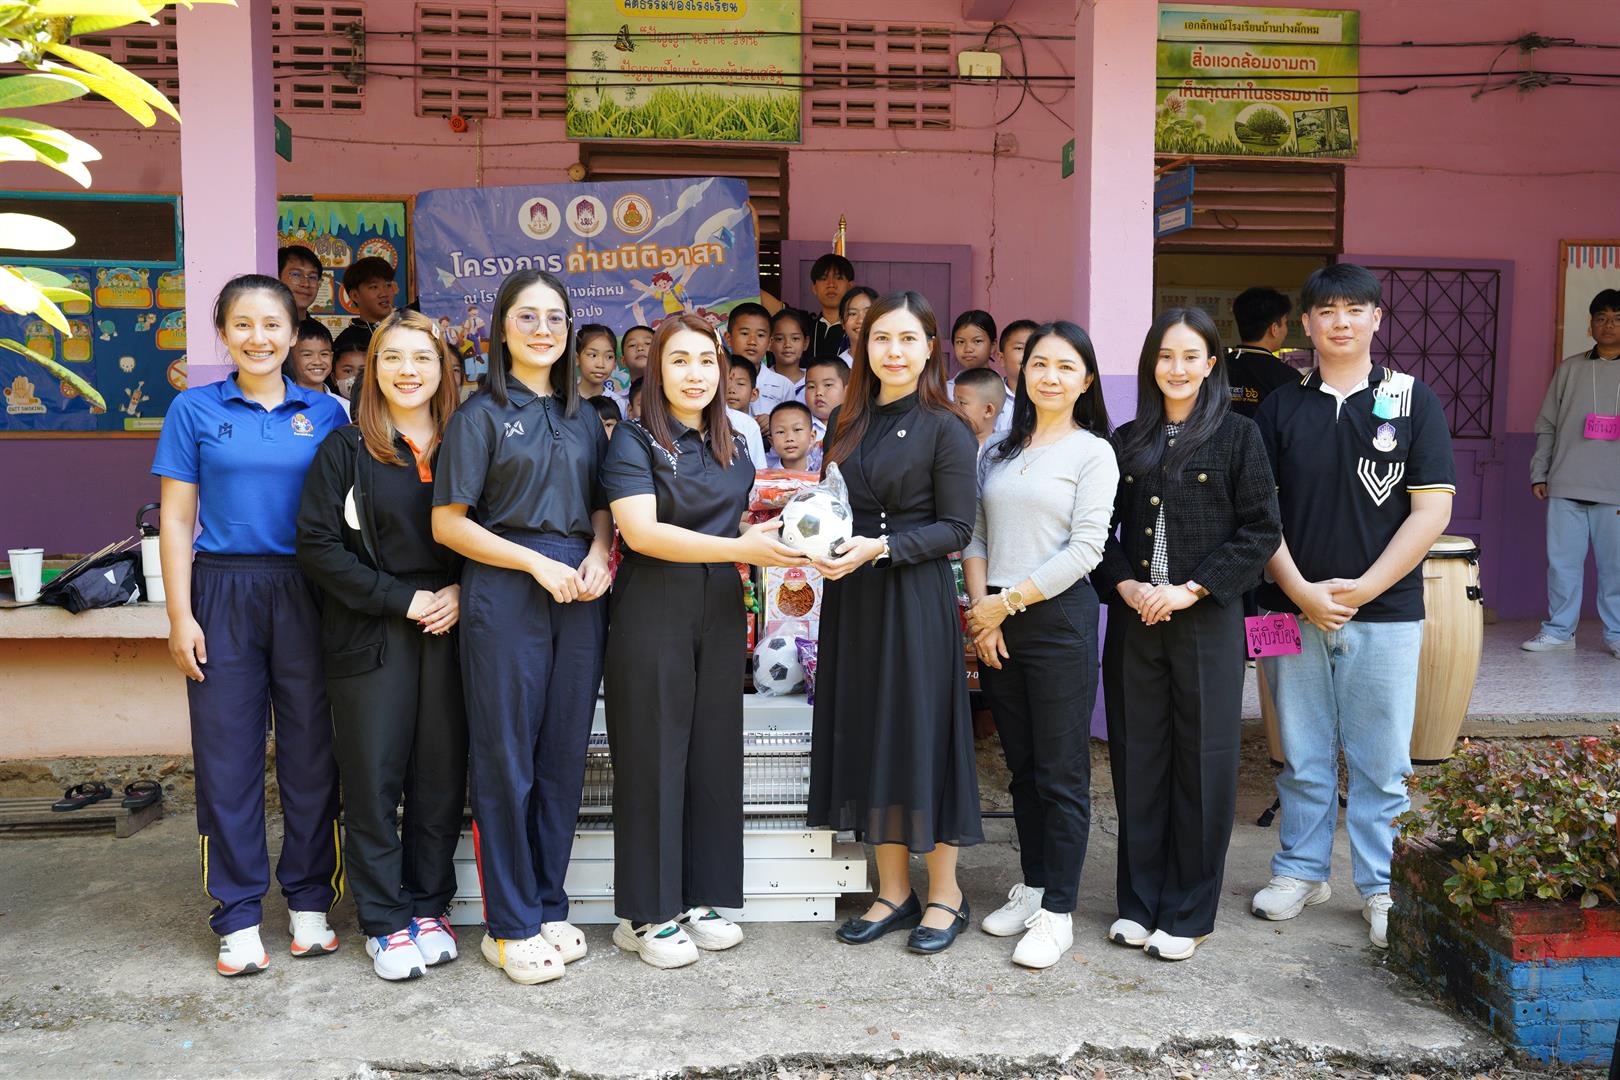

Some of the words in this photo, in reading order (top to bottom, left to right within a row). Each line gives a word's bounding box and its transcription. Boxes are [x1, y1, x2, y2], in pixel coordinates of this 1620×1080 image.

[1192, 47, 1316, 71] สิ่งแวดล้อมงามตา
[1179, 80, 1329, 104] เห็นคุณค่าในธรรมชาติ
[451, 251, 562, 278] โครงการ
[566, 243, 724, 273] ค่ายนิติอาสา
[567, 284, 624, 297] างผักหม
